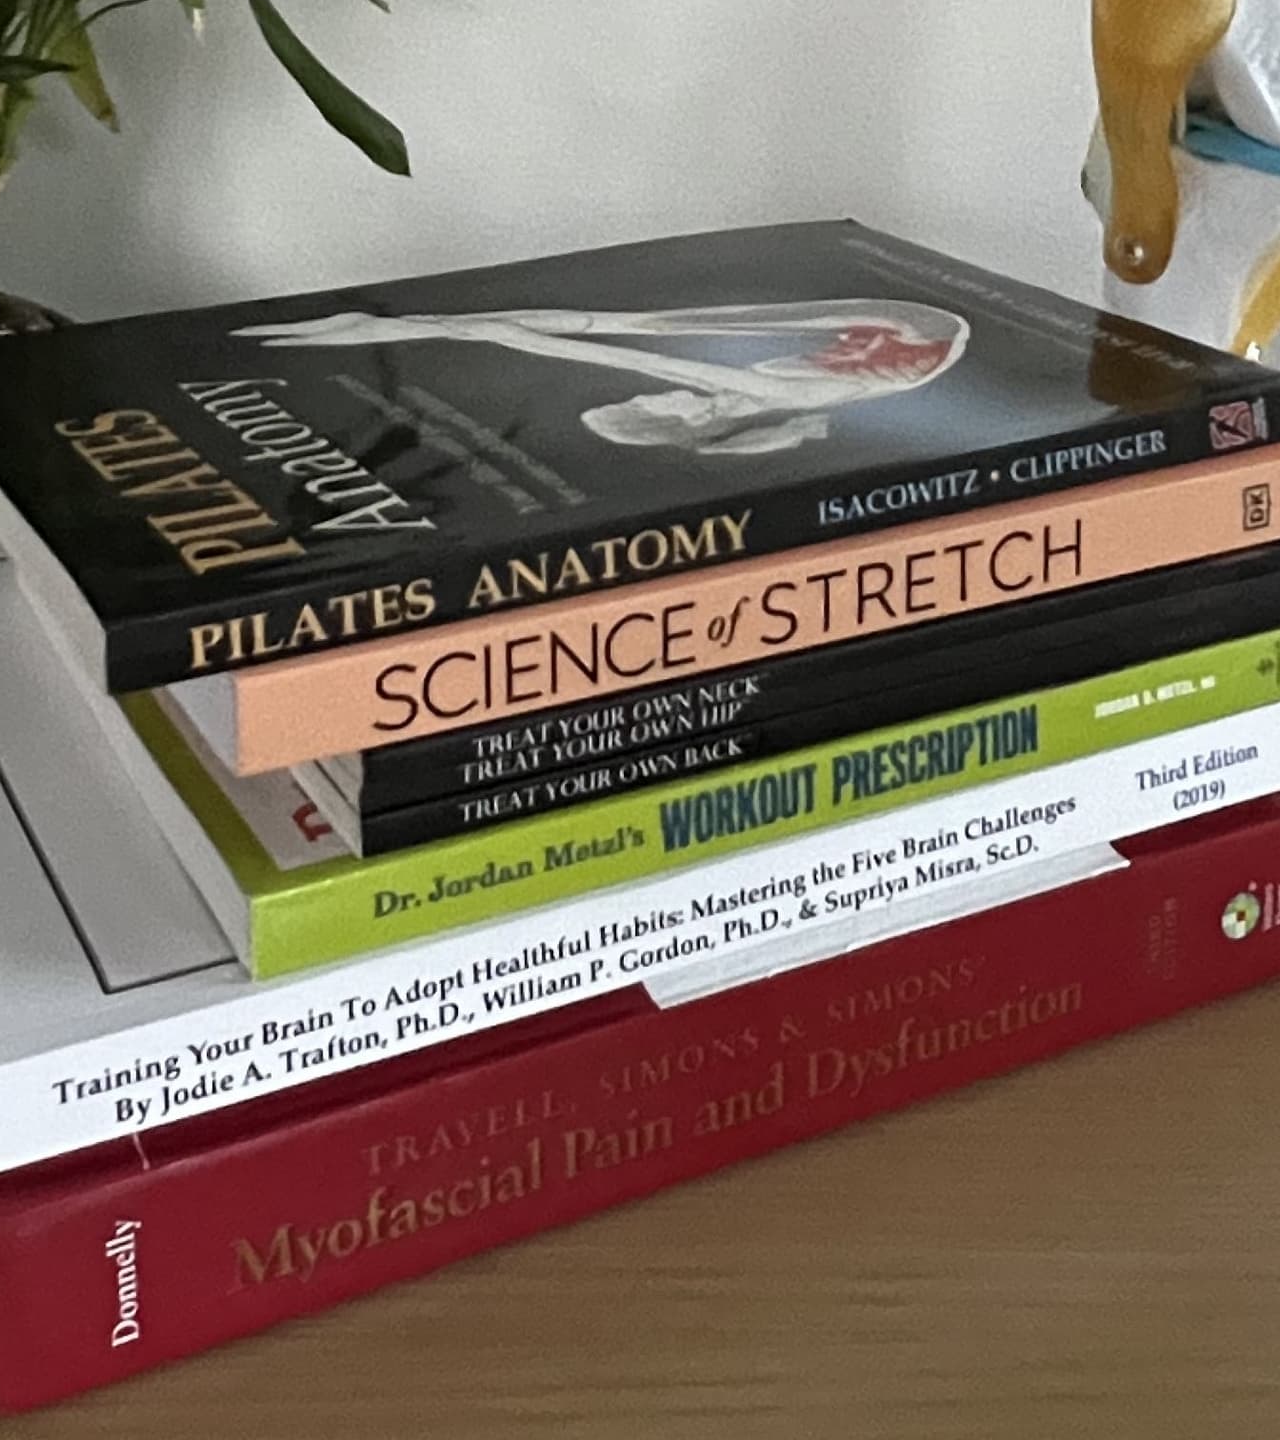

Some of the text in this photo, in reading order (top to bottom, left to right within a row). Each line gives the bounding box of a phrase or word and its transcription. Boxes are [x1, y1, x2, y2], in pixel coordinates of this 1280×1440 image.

[55, 408, 308, 576] PILATES
[178, 378, 439, 534] Anatomy
[819, 429, 1167, 524] ISACOWITZ CLIPPINGER
[189, 508, 754, 669] PILATES ANATOMY
[372, 518, 1084, 733] SCIENCE of STRETCH
[459, 737, 742, 823] TREAT YOUR OWN BACK
[462, 748, 542, 784] TREAT
[552, 731, 622, 761] YOUR
[630, 712, 694, 743] OWN
[473, 674, 760, 758] TREAT YOUR OWN NECK
[1135, 744, 1259, 792] Third Edition
[373, 704, 1039, 918] Dr. Jordan Metzl's WORKOUT PRESCRIPTION
[1173, 779, 1226, 811] (2019)
[52, 794, 1078, 1105] Training Your Brain To Adopt Healthful Habits: Mastering the Five Brain Challenges
[116, 1096, 151, 1125] By
[161, 1071, 234, 1116] Jodie
[242, 1063, 273, 1088] A.
[279, 1027, 388, 1074] Trafton,
[396, 1003, 475, 1040] Ph.D.,
[483, 972, 582, 1015] William
[590, 960, 613, 983] P.
[619, 928, 716, 973] Gordon,
[799, 898, 819, 921] &
[824, 872, 910, 915] Supriya
[915, 852, 982, 888] Misra,
[985, 833, 1040, 866] Sc.D.
[597, 1026, 761, 1098] SIMONS
[778, 1015, 807, 1044] &
[227, 981, 1084, 1295] Myofascial Pain and Dysfunction
[105, 1220, 142, 1347] Donnelly
